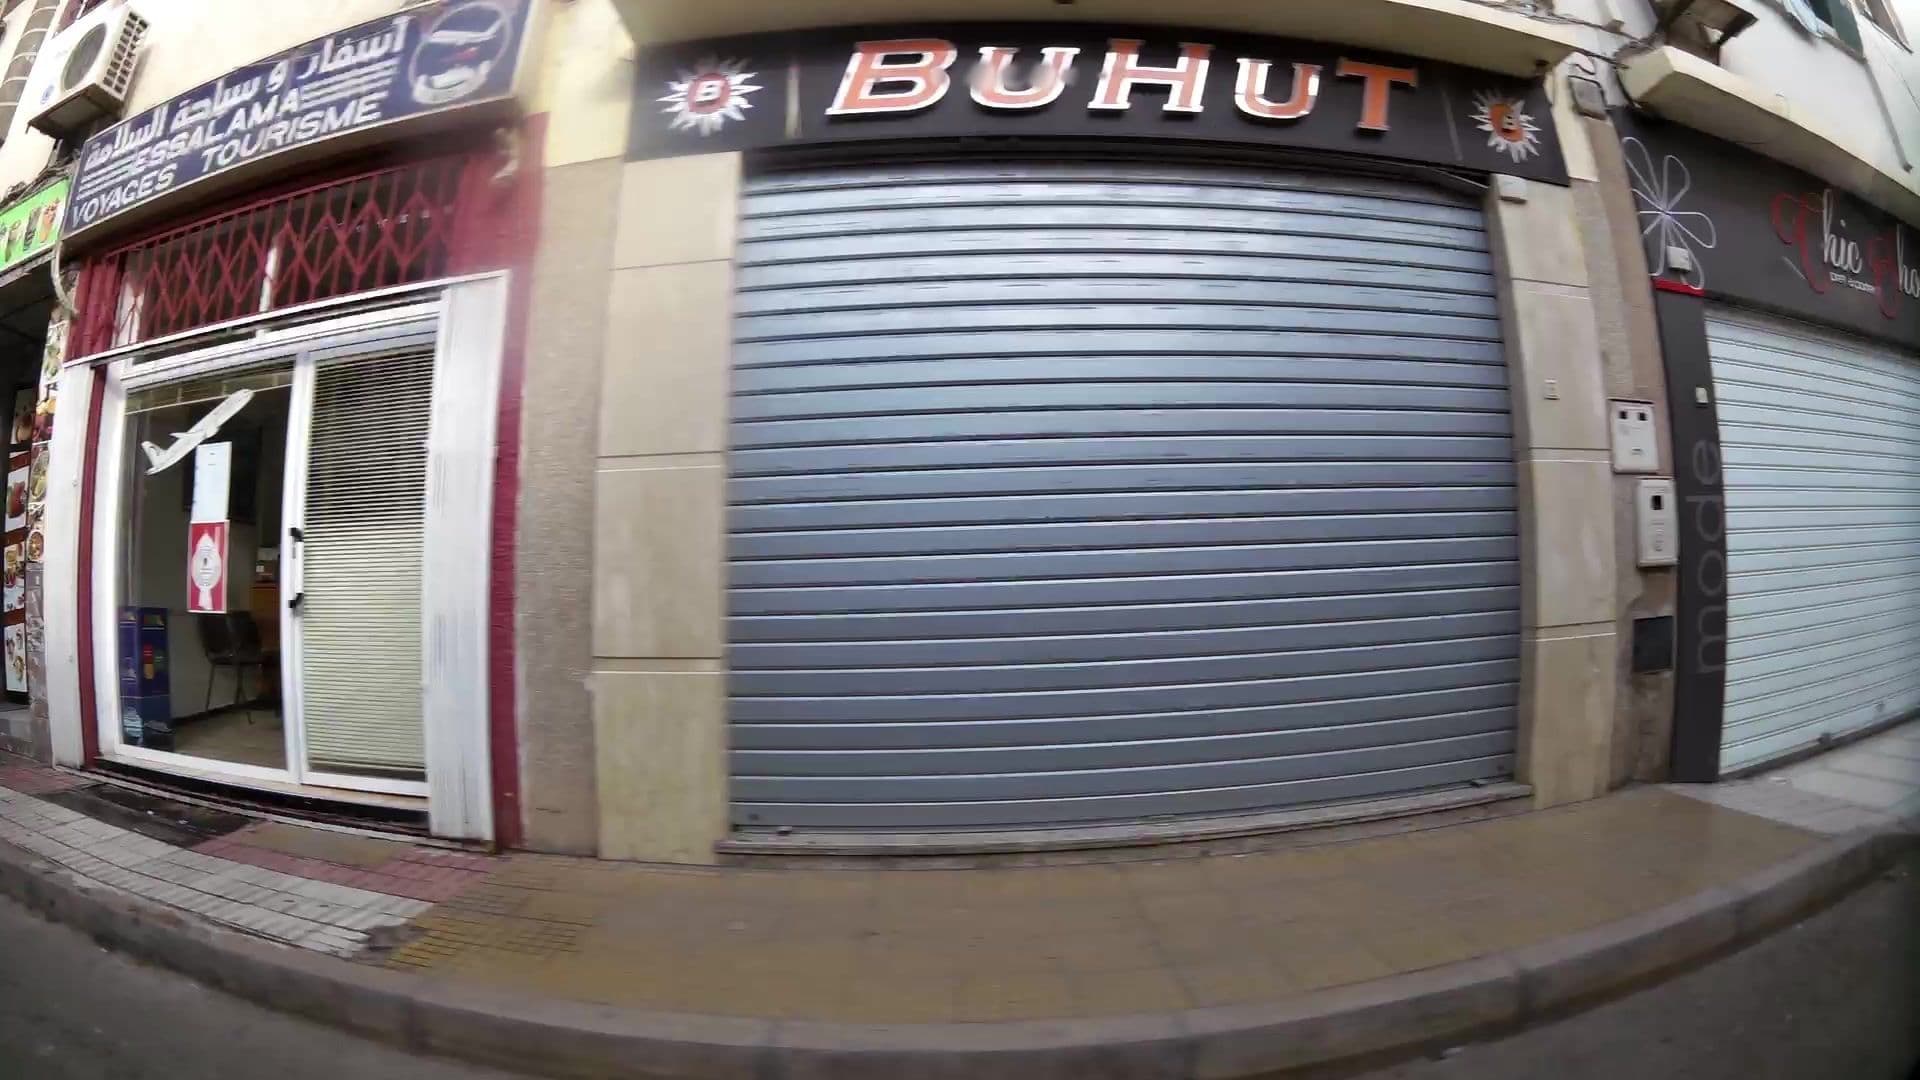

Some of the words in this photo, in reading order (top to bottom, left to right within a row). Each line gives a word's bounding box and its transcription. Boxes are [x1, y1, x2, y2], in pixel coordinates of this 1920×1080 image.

[266, 60, 289, 92] و
[825, 38, 1417, 131] BUHUT
[72, 163, 178, 228] VOYAGES
[201, 91, 389, 173] TOURISME
[133, 88, 299, 169] ESSALAMA
[1686, 440, 1726, 673] mode
